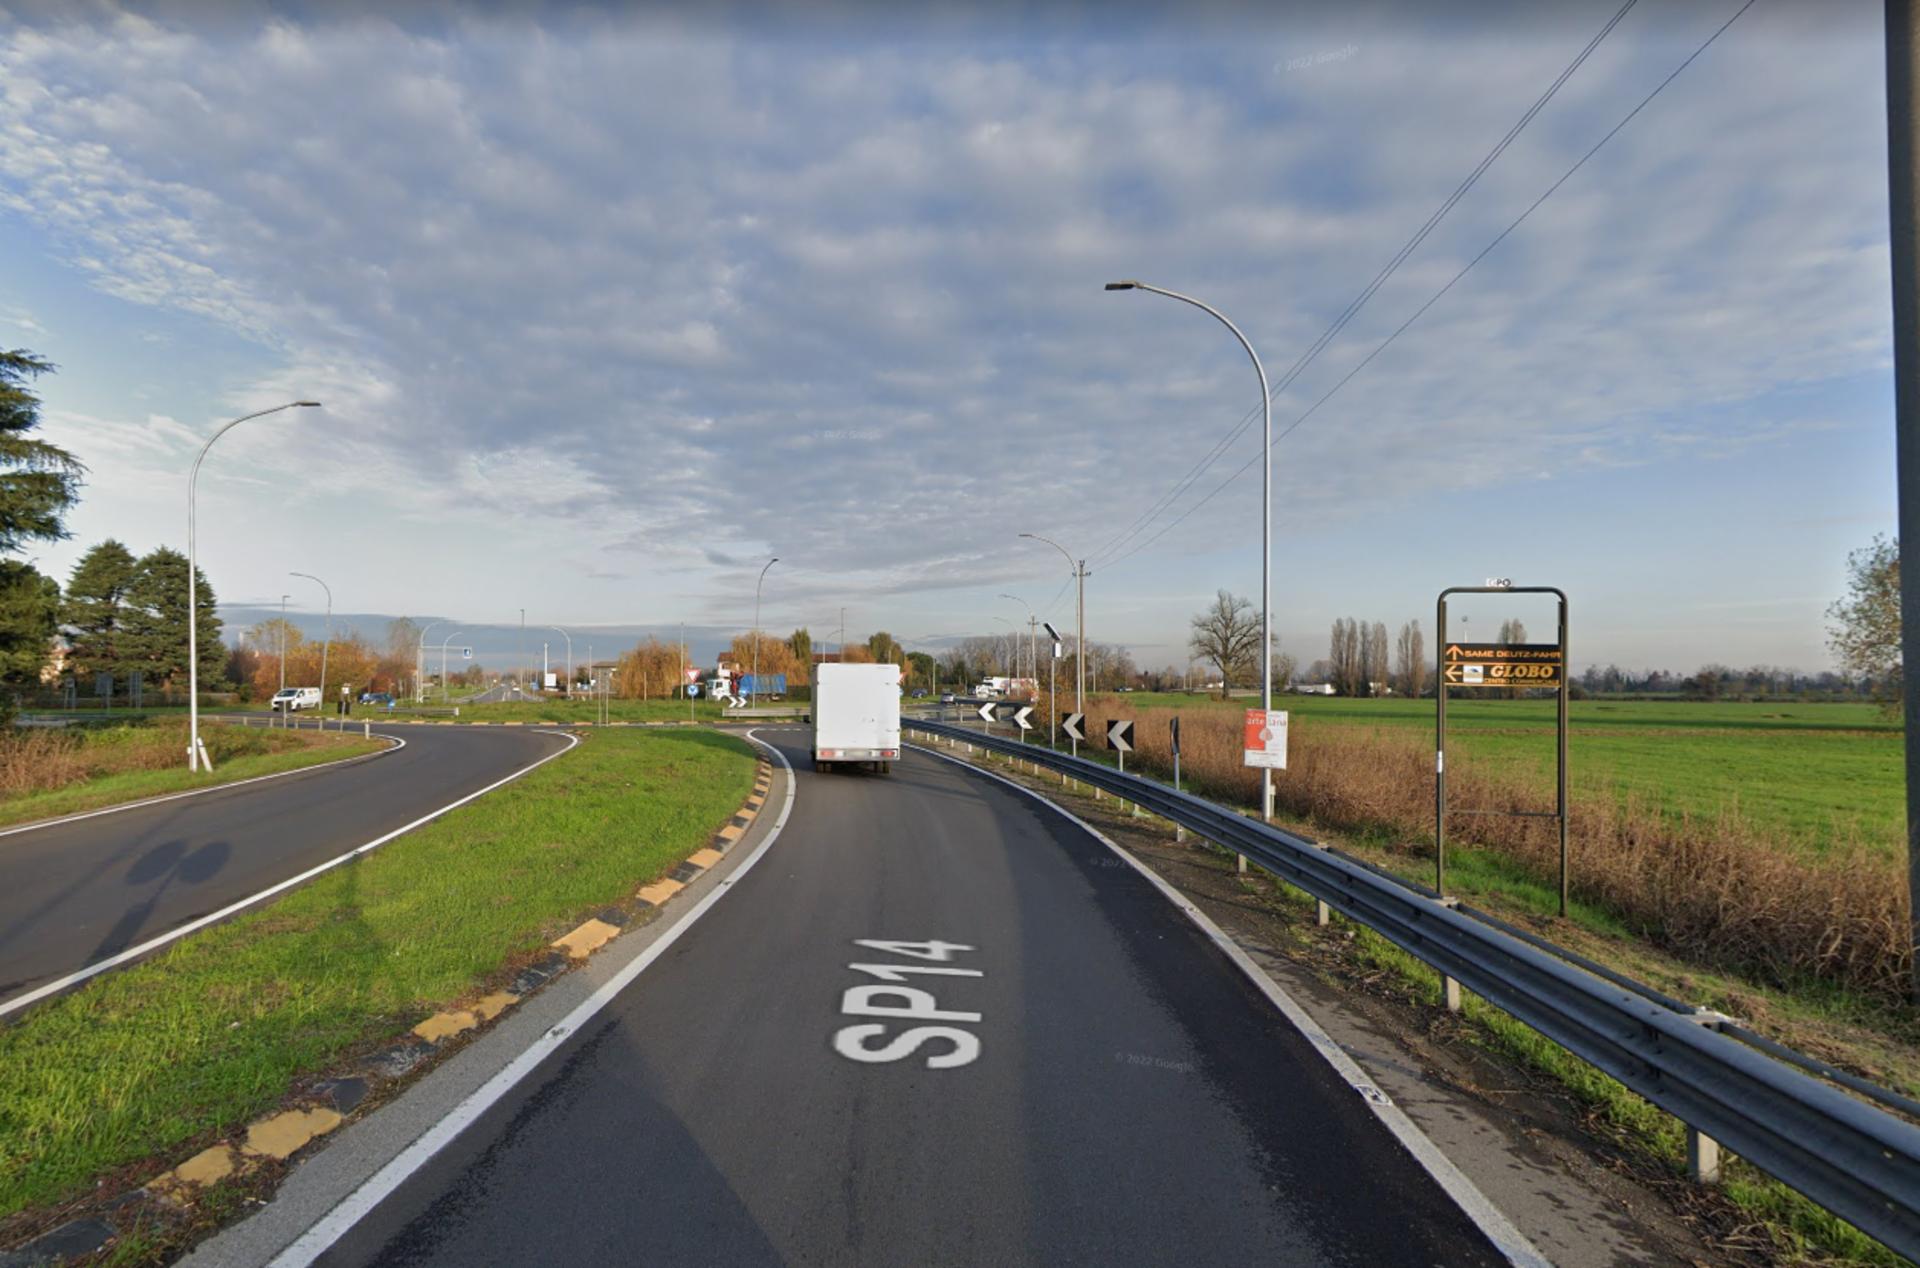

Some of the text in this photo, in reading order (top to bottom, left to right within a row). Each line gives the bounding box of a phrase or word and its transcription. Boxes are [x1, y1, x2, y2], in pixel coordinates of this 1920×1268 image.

[1464, 650, 1494, 658] SAME
[1490, 665, 1554, 678] GLOBO
[833, 938, 984, 1069] SP14
